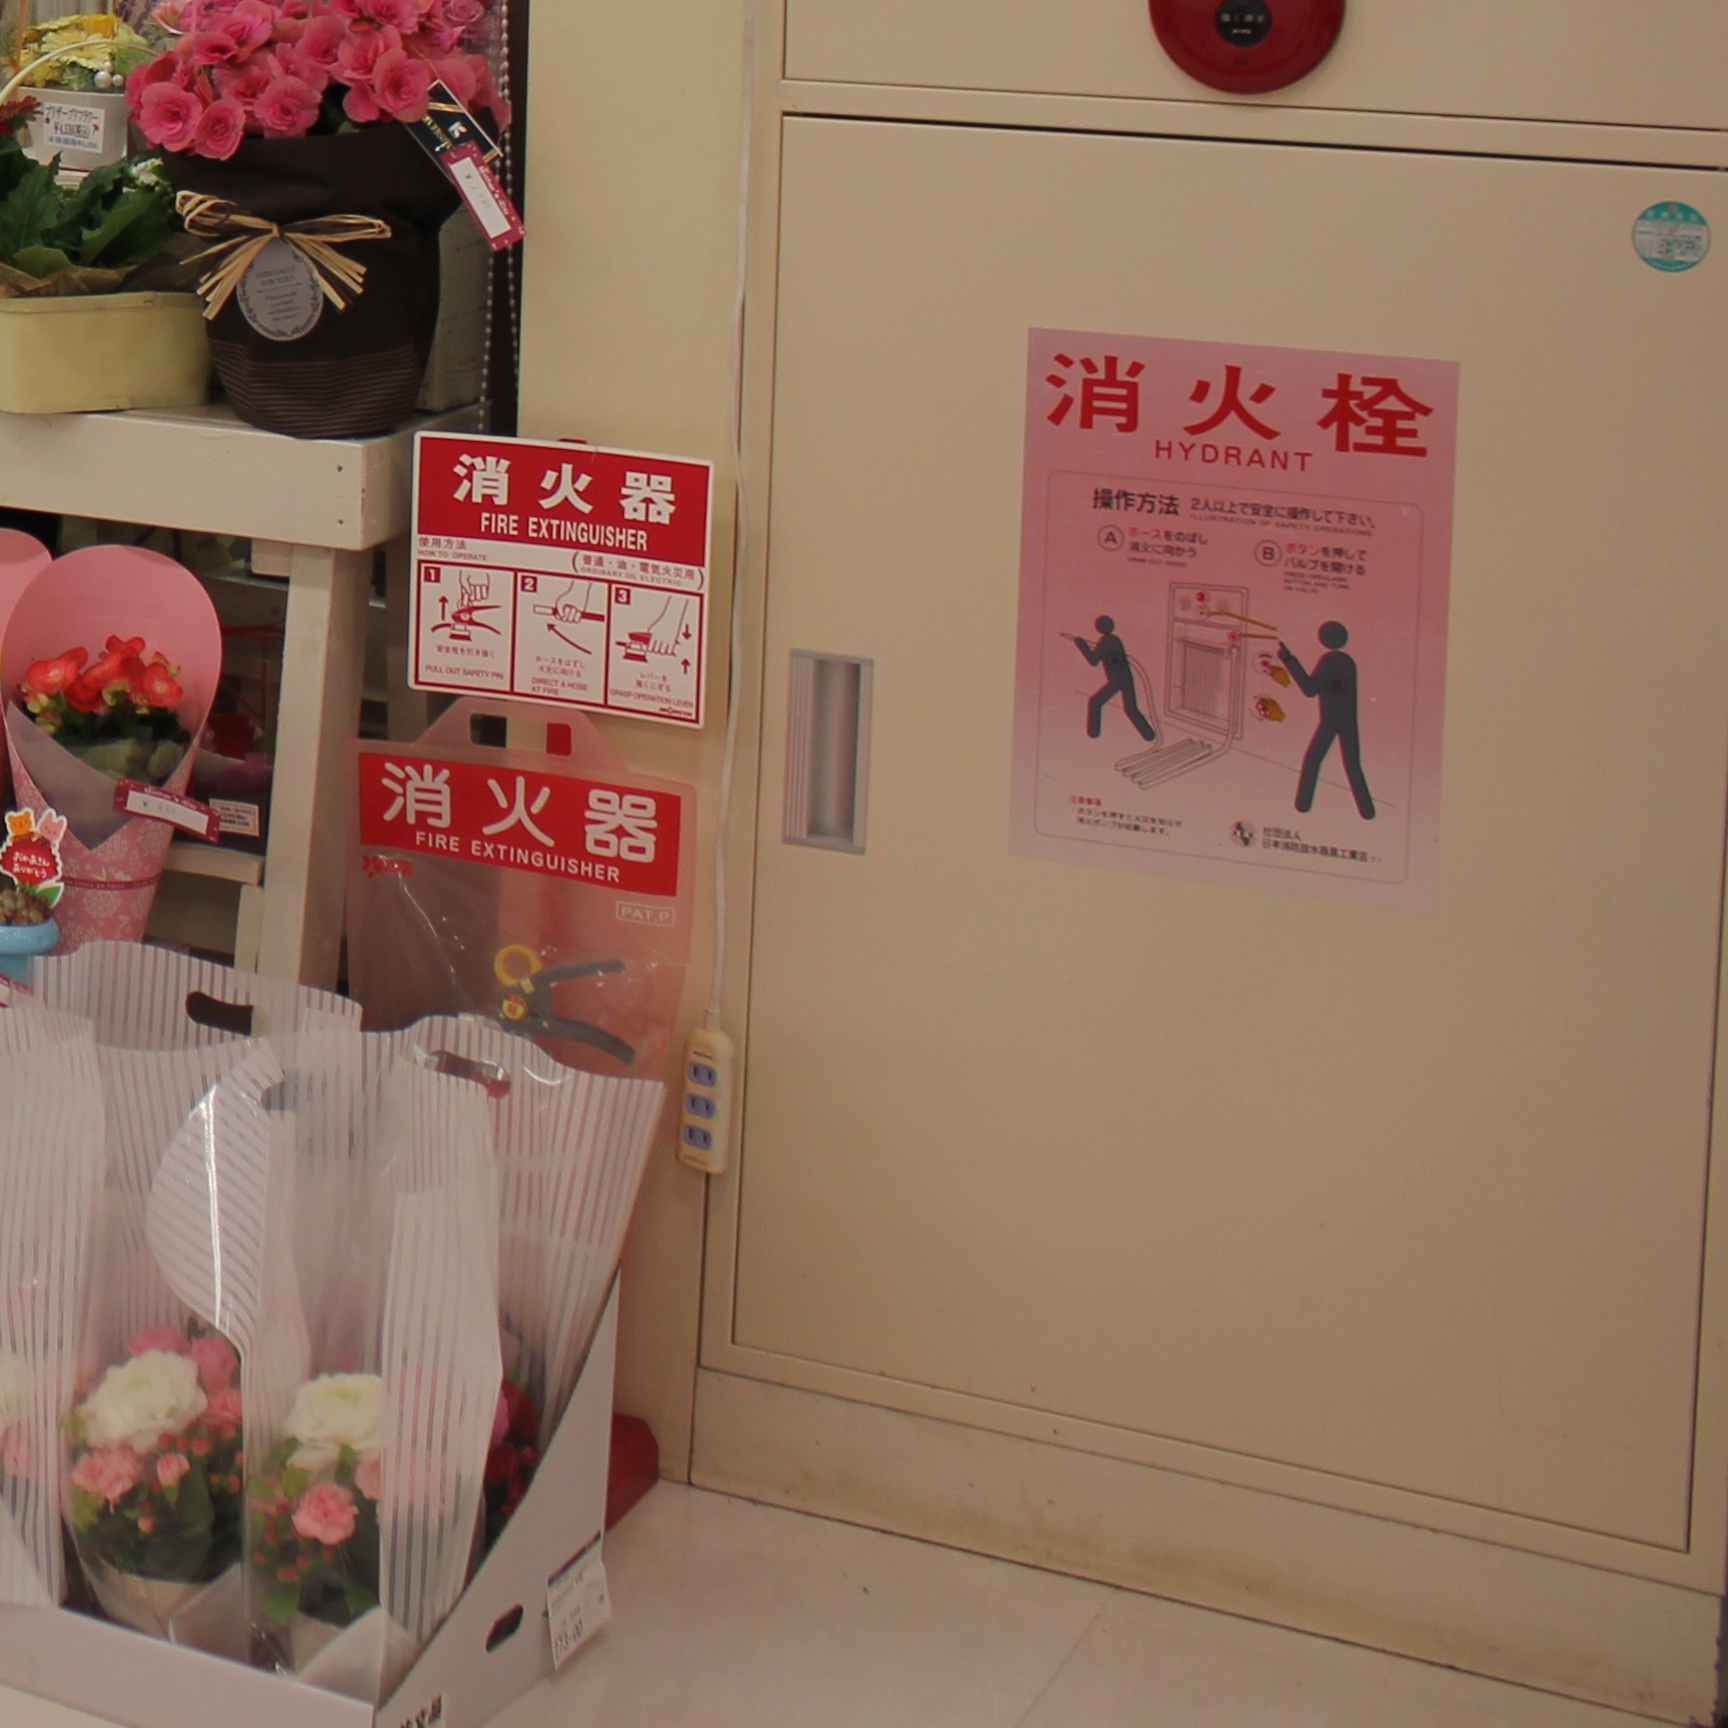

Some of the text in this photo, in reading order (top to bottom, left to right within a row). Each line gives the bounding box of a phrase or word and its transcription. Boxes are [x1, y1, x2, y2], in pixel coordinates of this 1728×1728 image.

[1045, 352, 1434, 458] 消火栓
[1154, 439, 1313, 473] HYDRANT
[453, 453, 676, 525] 消火器
[1093, 487, 1180, 517] 操作方法
[481, 512, 648, 551] FIRE EXTINGUISHER
[1128, 527, 1209, 545] ホースをのばし
[418, 537, 468, 551] 使用方法
[1285, 543, 1368, 561] ボタンを押して
[438, 551, 449, 559] TO
[452, 553, 487, 562] OPERATE
[1284, 557, 1366, 576] バルブを開ける
[426, 664, 504, 680] PULL OUT SAFETY PIN
[532, 677, 588, 691] DIRECT HOSE
[543, 687, 559, 696] FIRE
[632, 691, 671, 703] OPERATION
[671, 698, 694, 709] LEVER
[381, 762, 657, 864] 消火器
[415, 831, 621, 884] FIRE EXTINGUISHER
[620, 905, 671, 923] PAT.P
